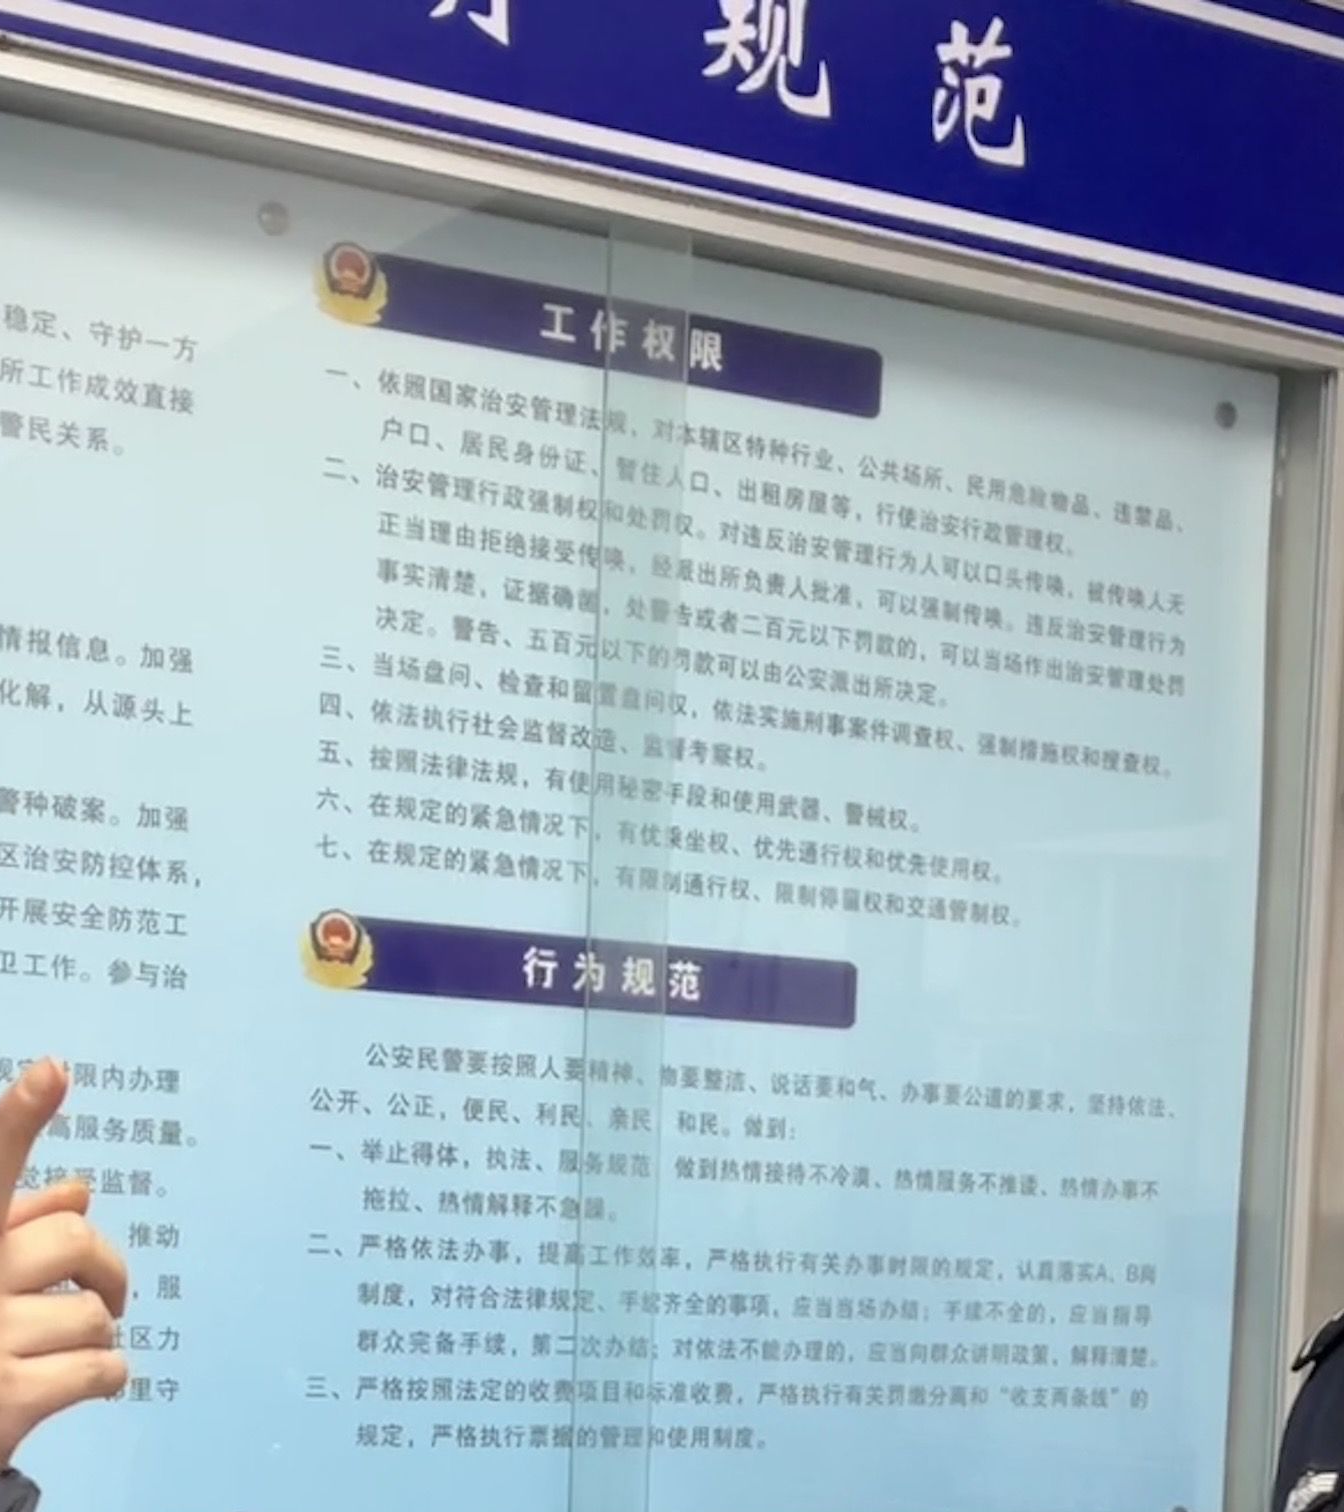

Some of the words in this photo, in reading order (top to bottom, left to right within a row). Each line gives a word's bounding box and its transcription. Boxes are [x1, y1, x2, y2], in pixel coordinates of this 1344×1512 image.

[541, 303, 725, 371] 工作权限
[522, 947, 701, 999] 行为规范
